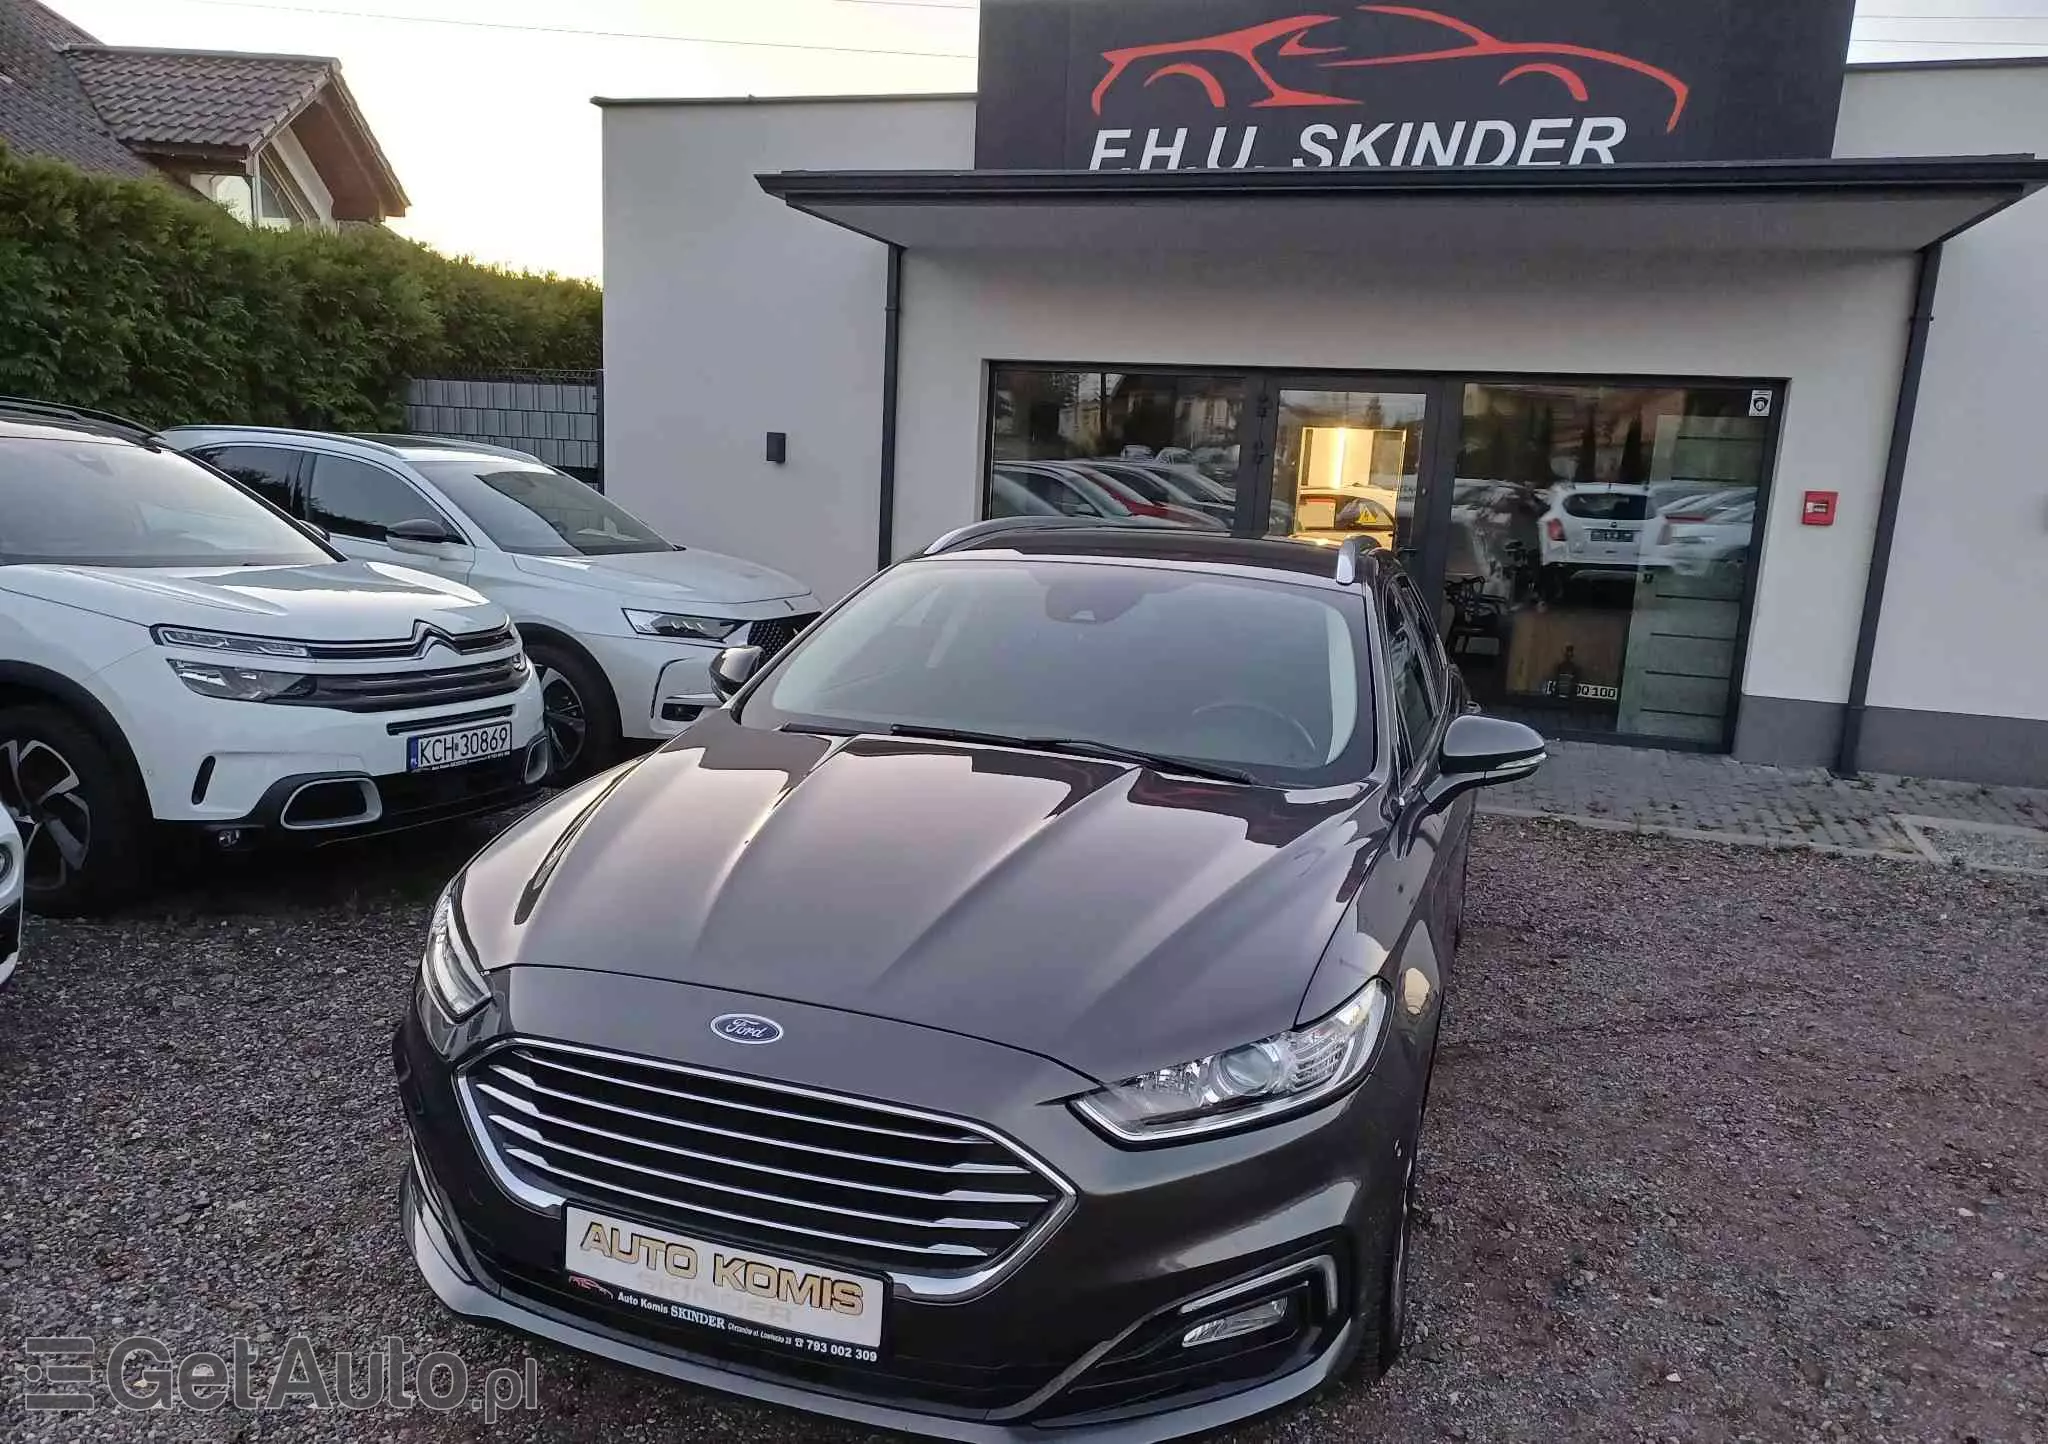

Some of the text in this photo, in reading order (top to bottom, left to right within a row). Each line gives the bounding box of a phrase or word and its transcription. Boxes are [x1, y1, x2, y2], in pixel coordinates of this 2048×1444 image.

[1088, 117, 1627, 171] FHU SKINDER
[420, 735, 455, 764] KCH
[460, 727, 508, 756] 30869
[726, 1019, 768, 1038] Ford
[579, 1221, 864, 1316] AUTO KOMIS
[618, 1291, 638, 1306] Auto
[640, 1298, 669, 1314] Komis
[670, 1304, 726, 1330] SKINDER
[806, 1339, 828, 1353] 793
[830, 1344, 852, 1358] 002
[855, 1349, 878, 1363] 309
